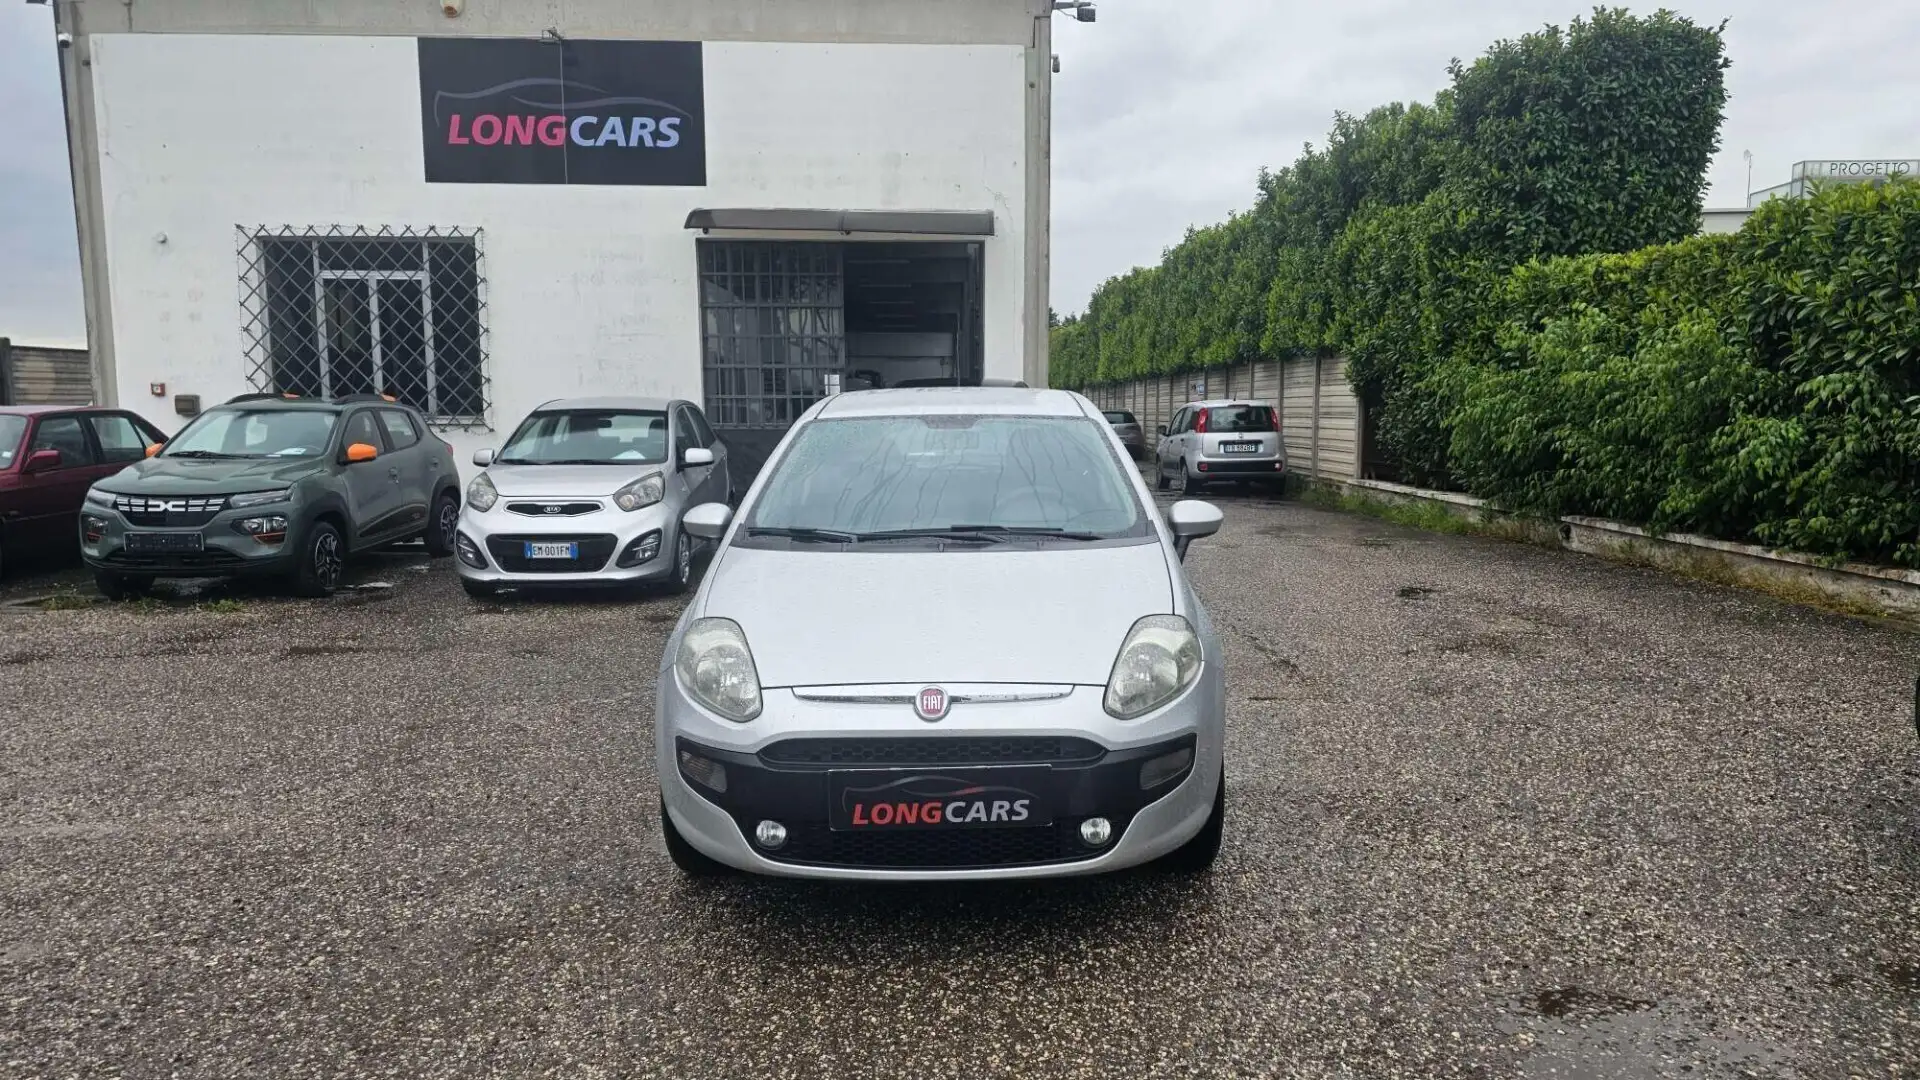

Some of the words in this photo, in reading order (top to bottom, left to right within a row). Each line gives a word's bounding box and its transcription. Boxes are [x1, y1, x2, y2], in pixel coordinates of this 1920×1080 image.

[448, 114, 681, 148] LONGCARS
[1829, 162, 1910, 176] PROGETTO
[923, 695, 942, 711] FIAT
[852, 799, 1030, 825] LONGCARS
